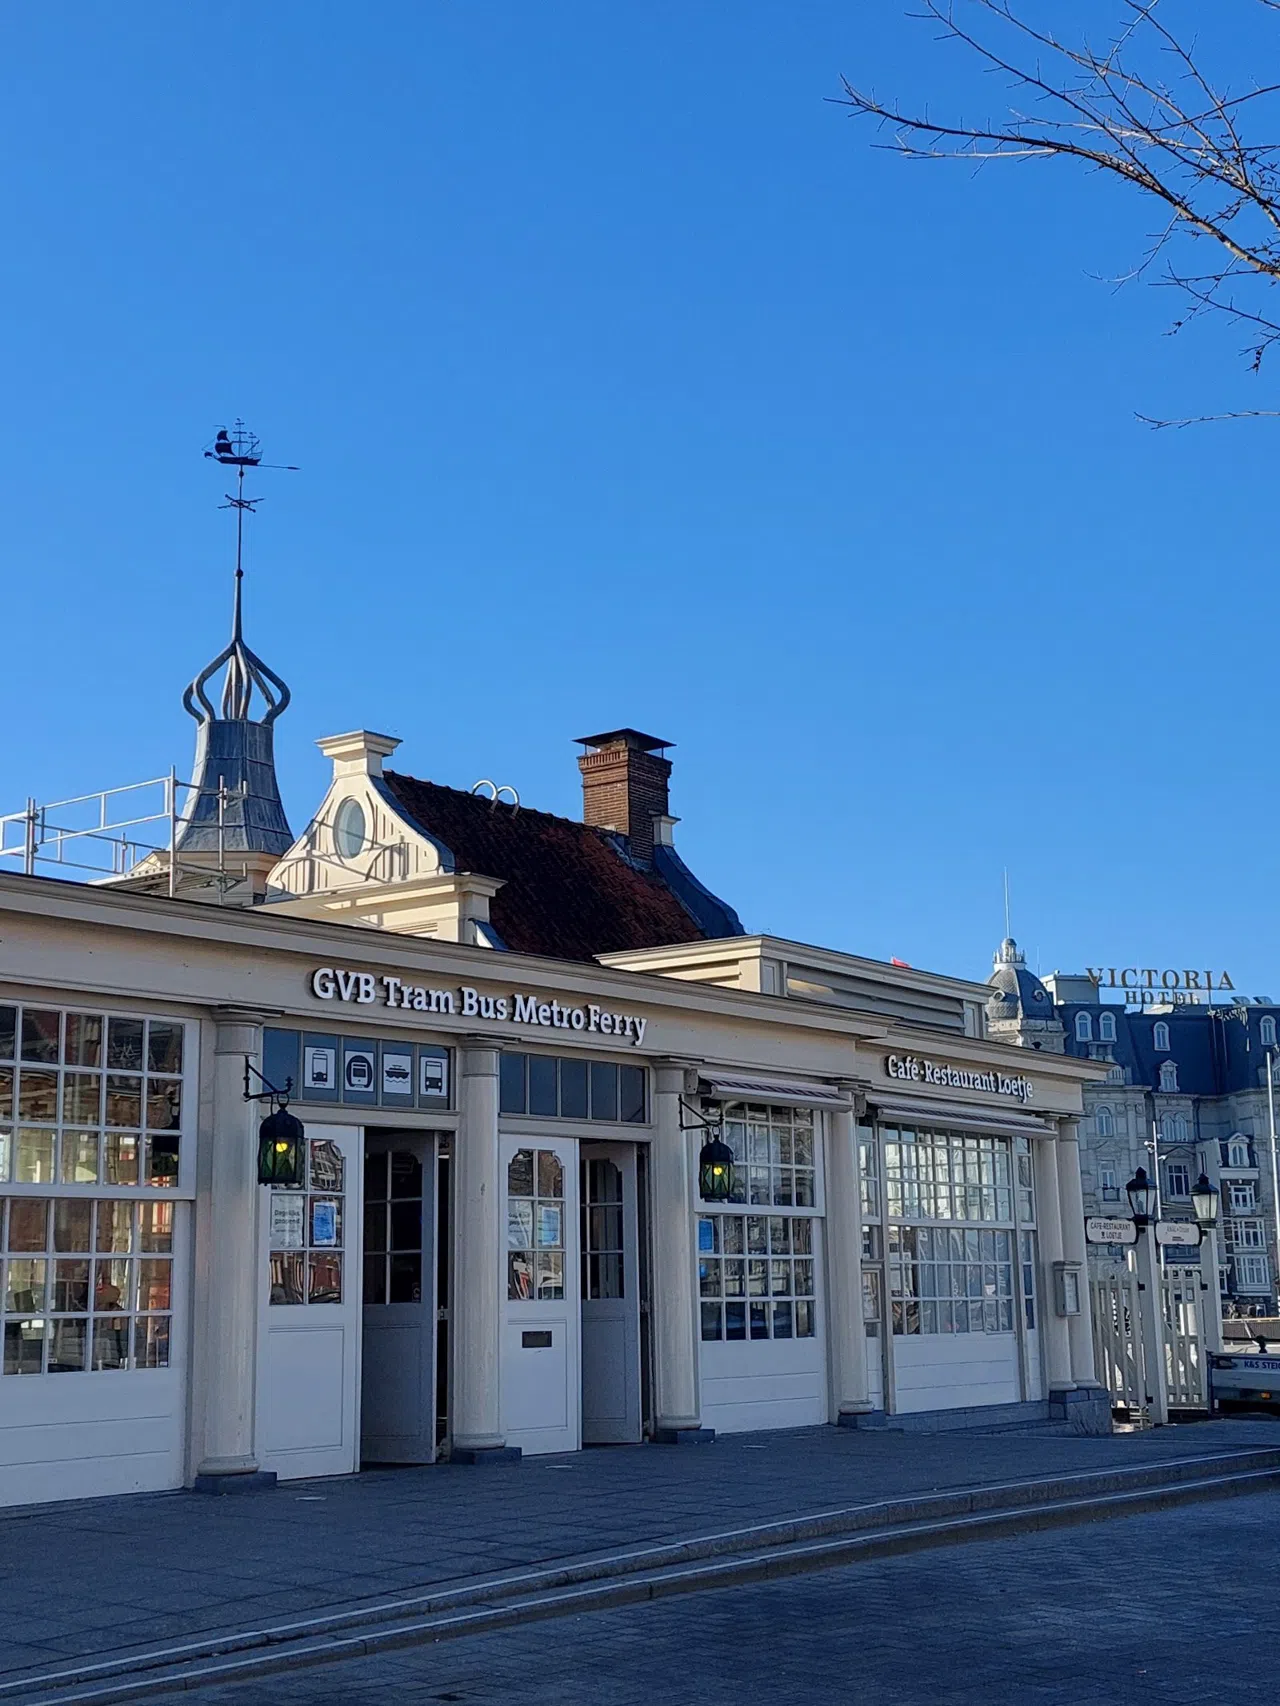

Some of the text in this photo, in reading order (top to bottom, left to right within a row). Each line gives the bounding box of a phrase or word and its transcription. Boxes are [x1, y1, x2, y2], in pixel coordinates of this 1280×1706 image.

[1085, 967, 1236, 991] VICTORIA
[312, 968, 648, 1046] GVB Tram Bus Metro Ferry
[1124, 990, 1201, 1006] HOTEL
[998, 1072, 1034, 1103] Loetje
